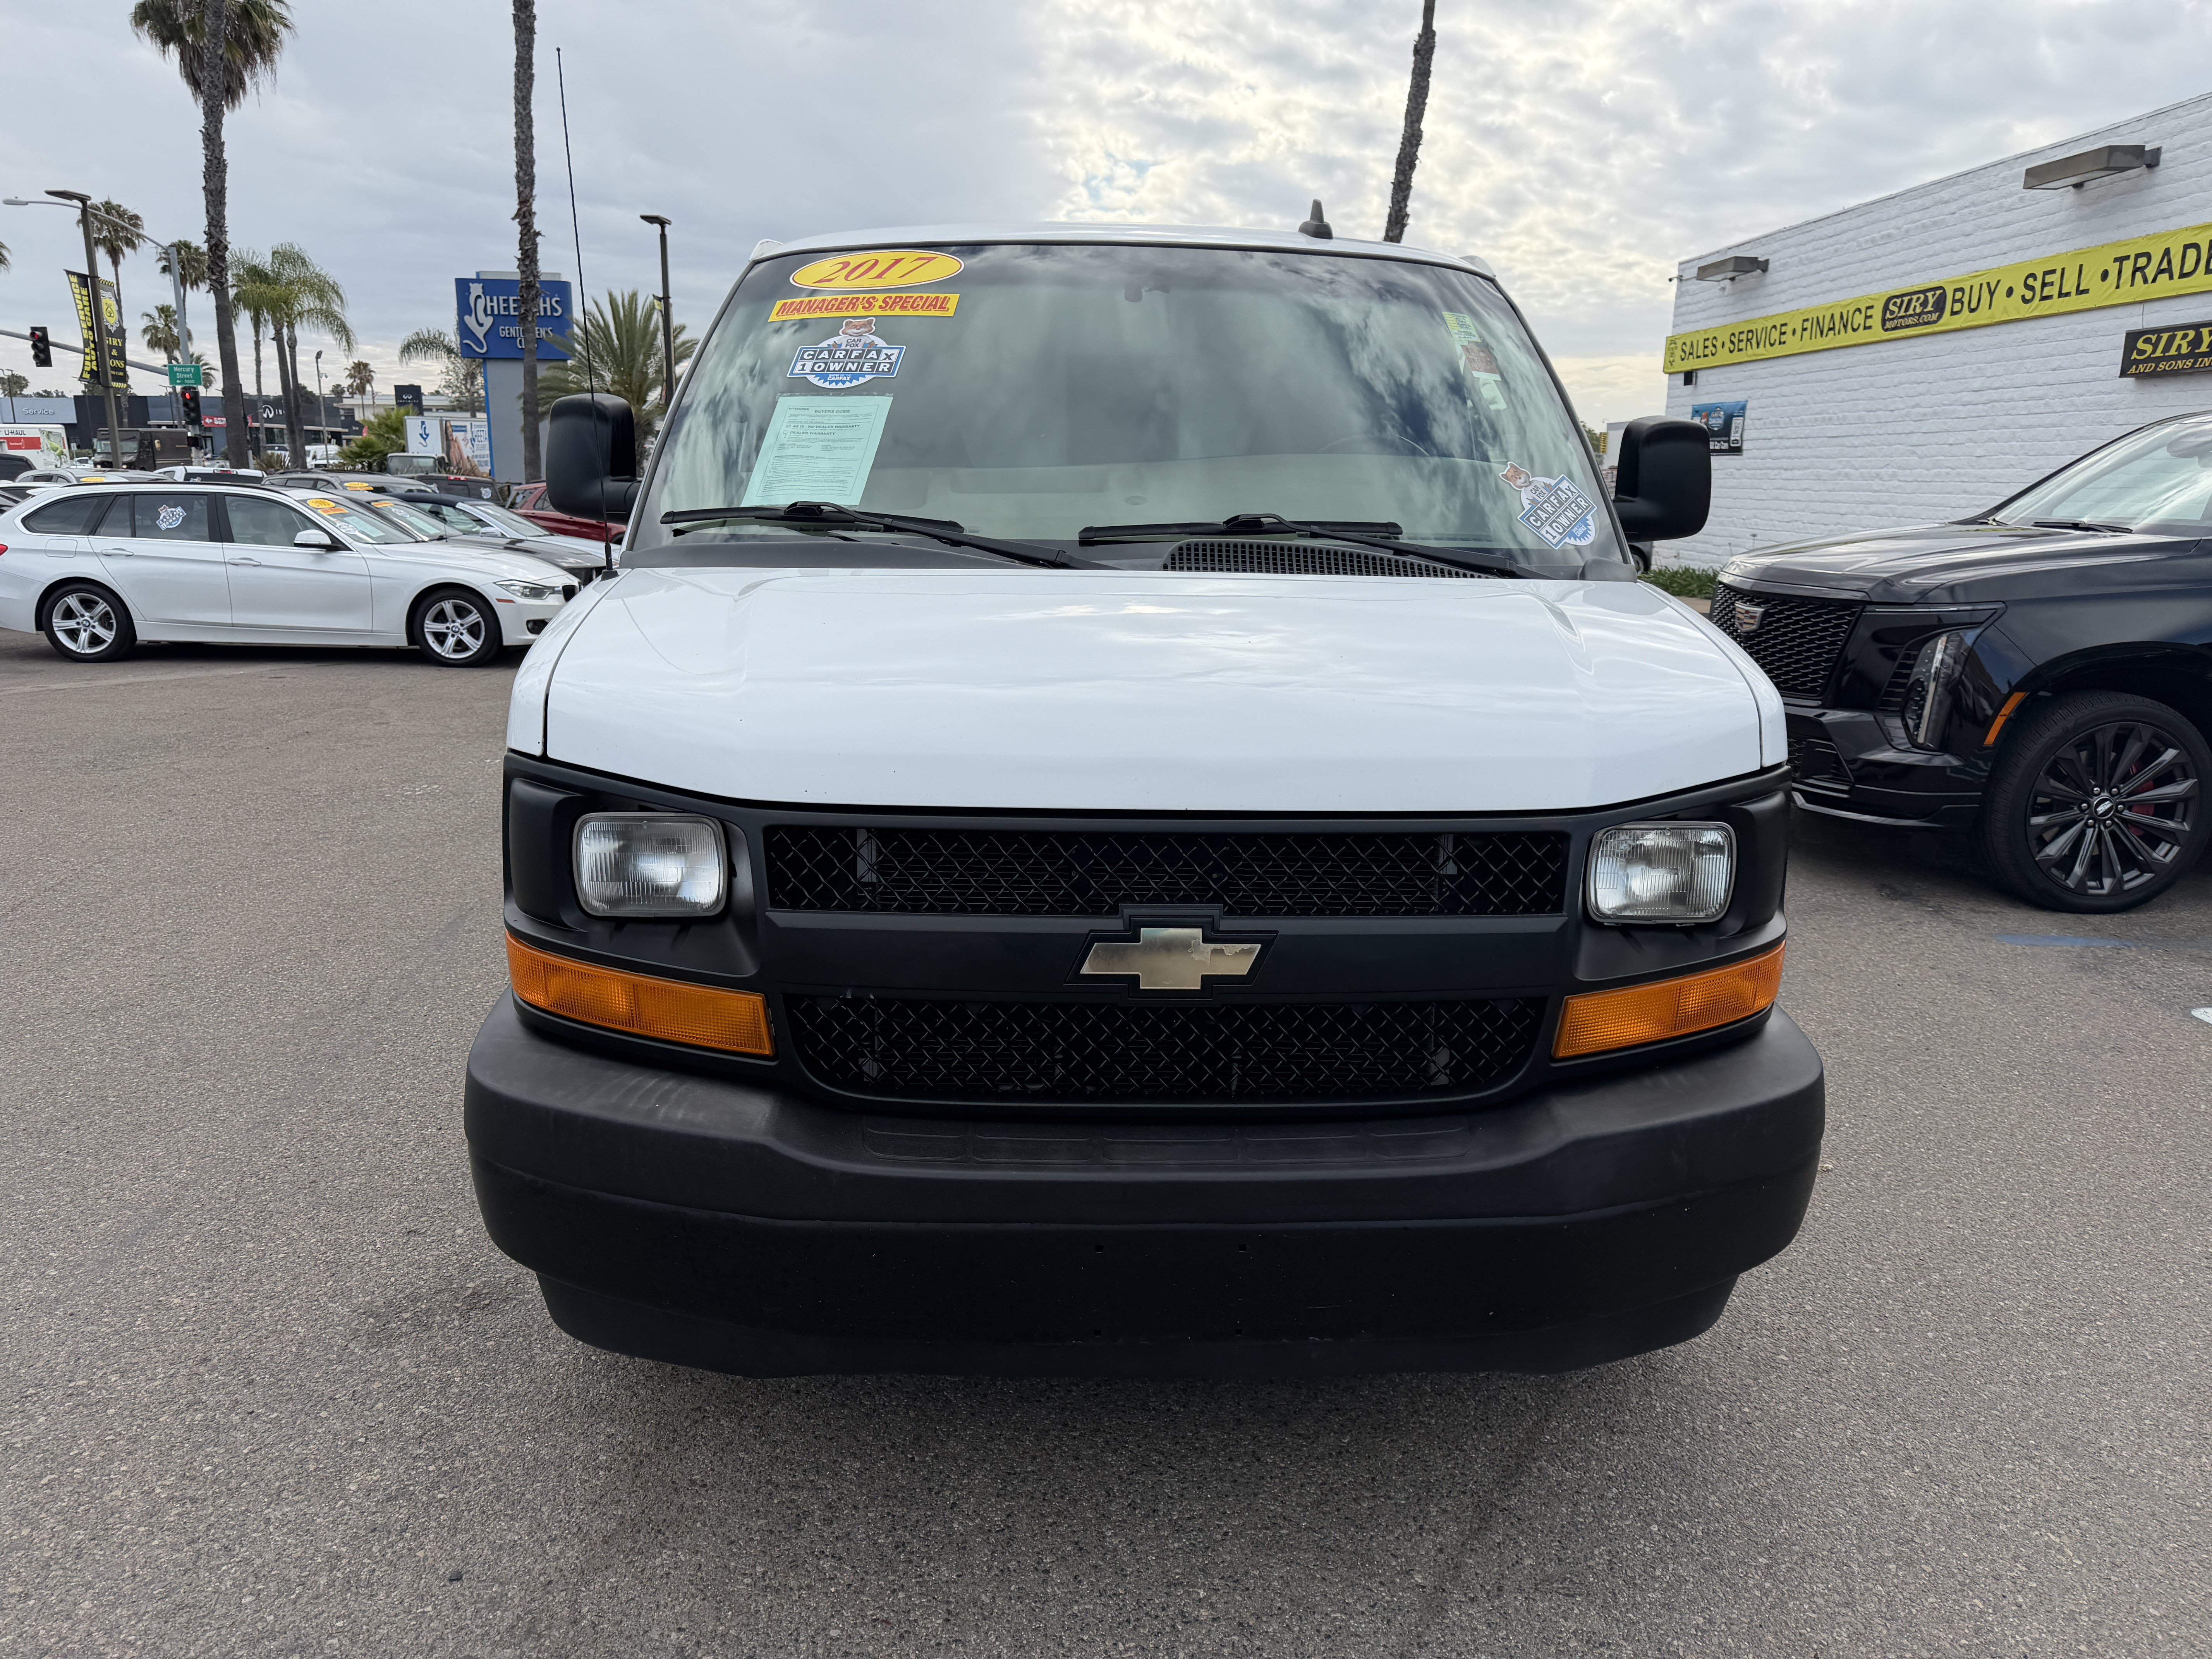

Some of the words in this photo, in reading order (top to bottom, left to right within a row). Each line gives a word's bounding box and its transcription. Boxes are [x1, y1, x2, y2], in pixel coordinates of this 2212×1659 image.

[812, 256, 939, 284] 2017
[1950, 279, 2002, 316] BUY
[2021, 263, 2090, 305] SELL
[69, 274, 88, 339] SERVICE
[80, 287, 92, 327] CARE
[776, 296, 878, 317] MANAGER'S
[878, 295, 951, 313] SPECIAL
[1885, 290, 1943, 319] SIRY
[499, 326, 553, 338] GENTLEN'S
[1680, 336, 1718, 361] SALES
[1728, 322, 1787, 354] SERVICE
[1800, 305, 1874, 342] FINANCE
[1884, 312, 1940, 329] MOTORS.COM
[82, 346, 91, 379] FULL
[88, 330, 98, 371] AUTO
[110, 359, 124, 368] ONS
[804, 350, 896, 361] CARFAX
[2127, 363, 2155, 374] AND
[2157, 359, 2194, 371] SONS
[2194, 357, 2212, 368] IN
[1530, 485, 1540, 495] CAR
[1536, 491, 1547, 500] FOX
[1529, 486, 1576, 527] CARFAX
